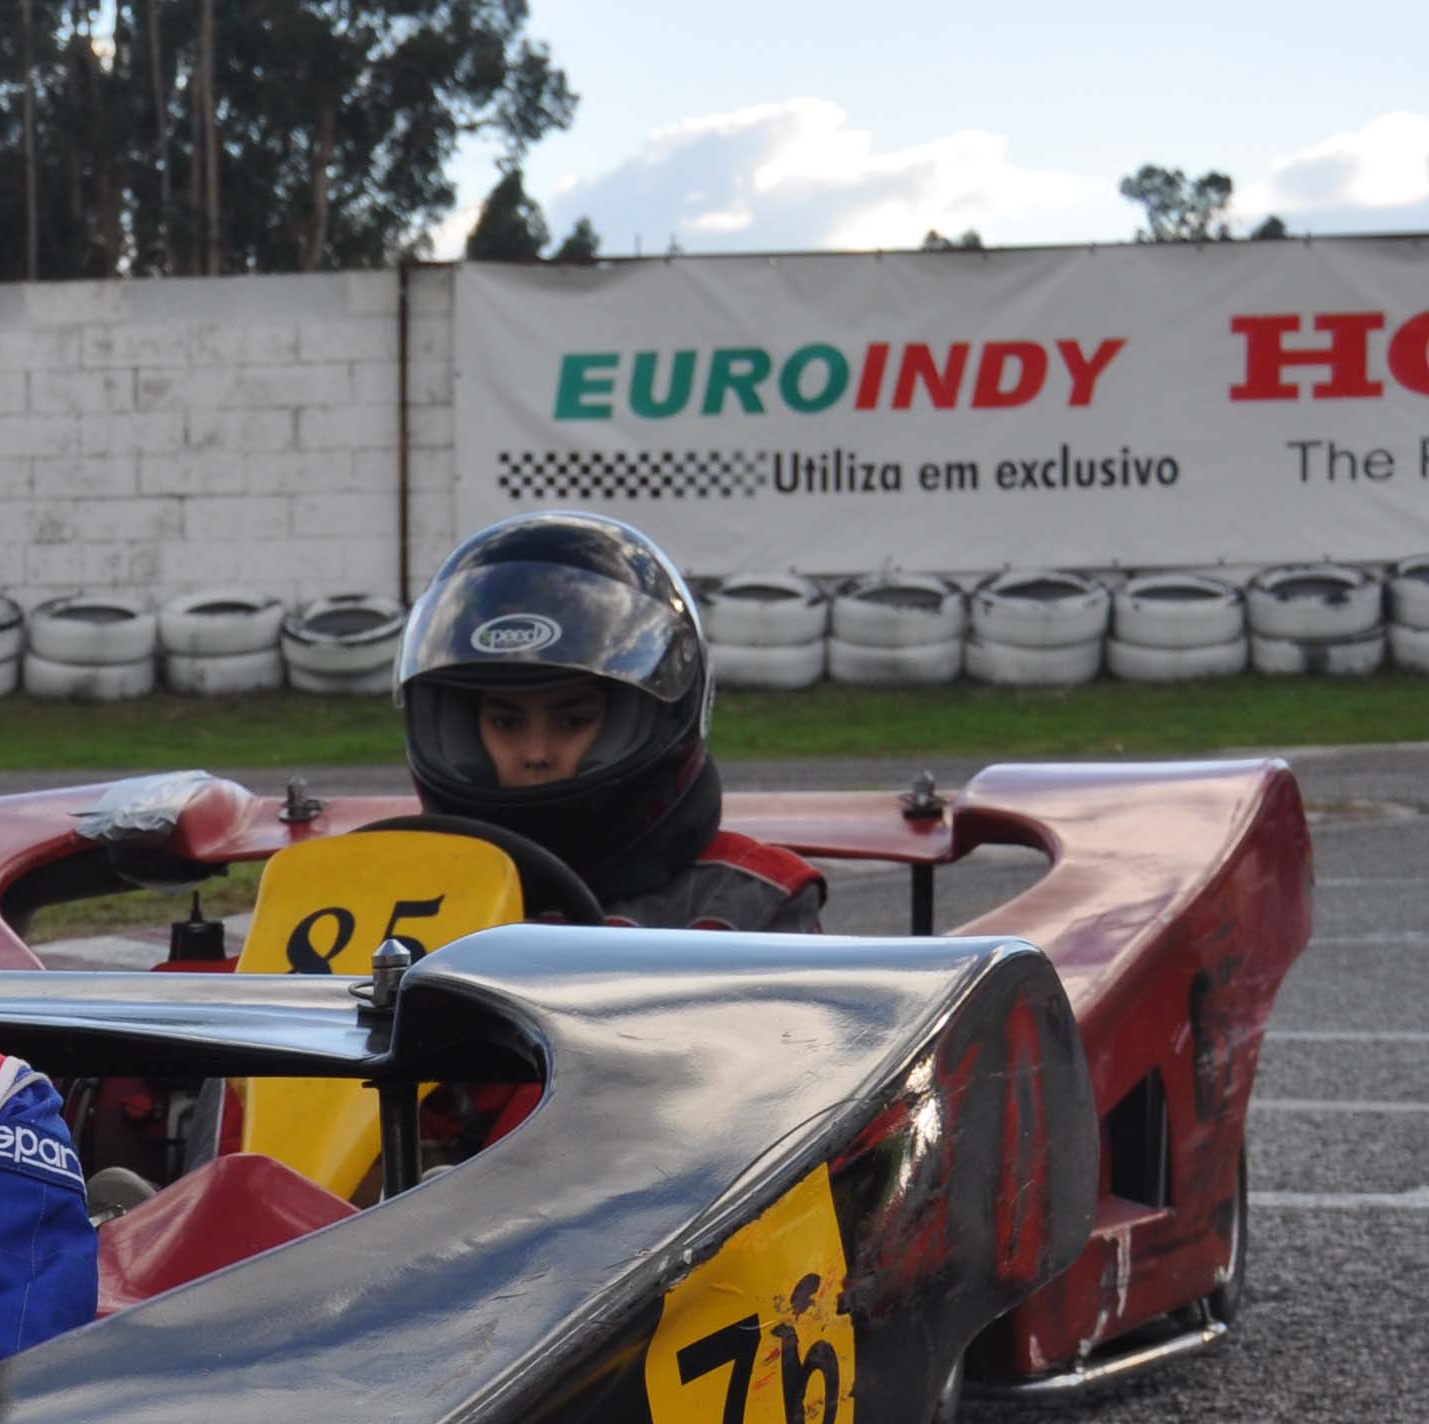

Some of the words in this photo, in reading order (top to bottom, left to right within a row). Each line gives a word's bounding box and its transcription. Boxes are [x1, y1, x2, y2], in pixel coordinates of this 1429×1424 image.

[553, 338, 1129, 421] EUROINDY
[773, 449, 903, 494] Utiliza
[918, 459, 979, 492] em
[996, 443, 1180, 488] exclusivo
[1286, 439, 1396, 482] The
